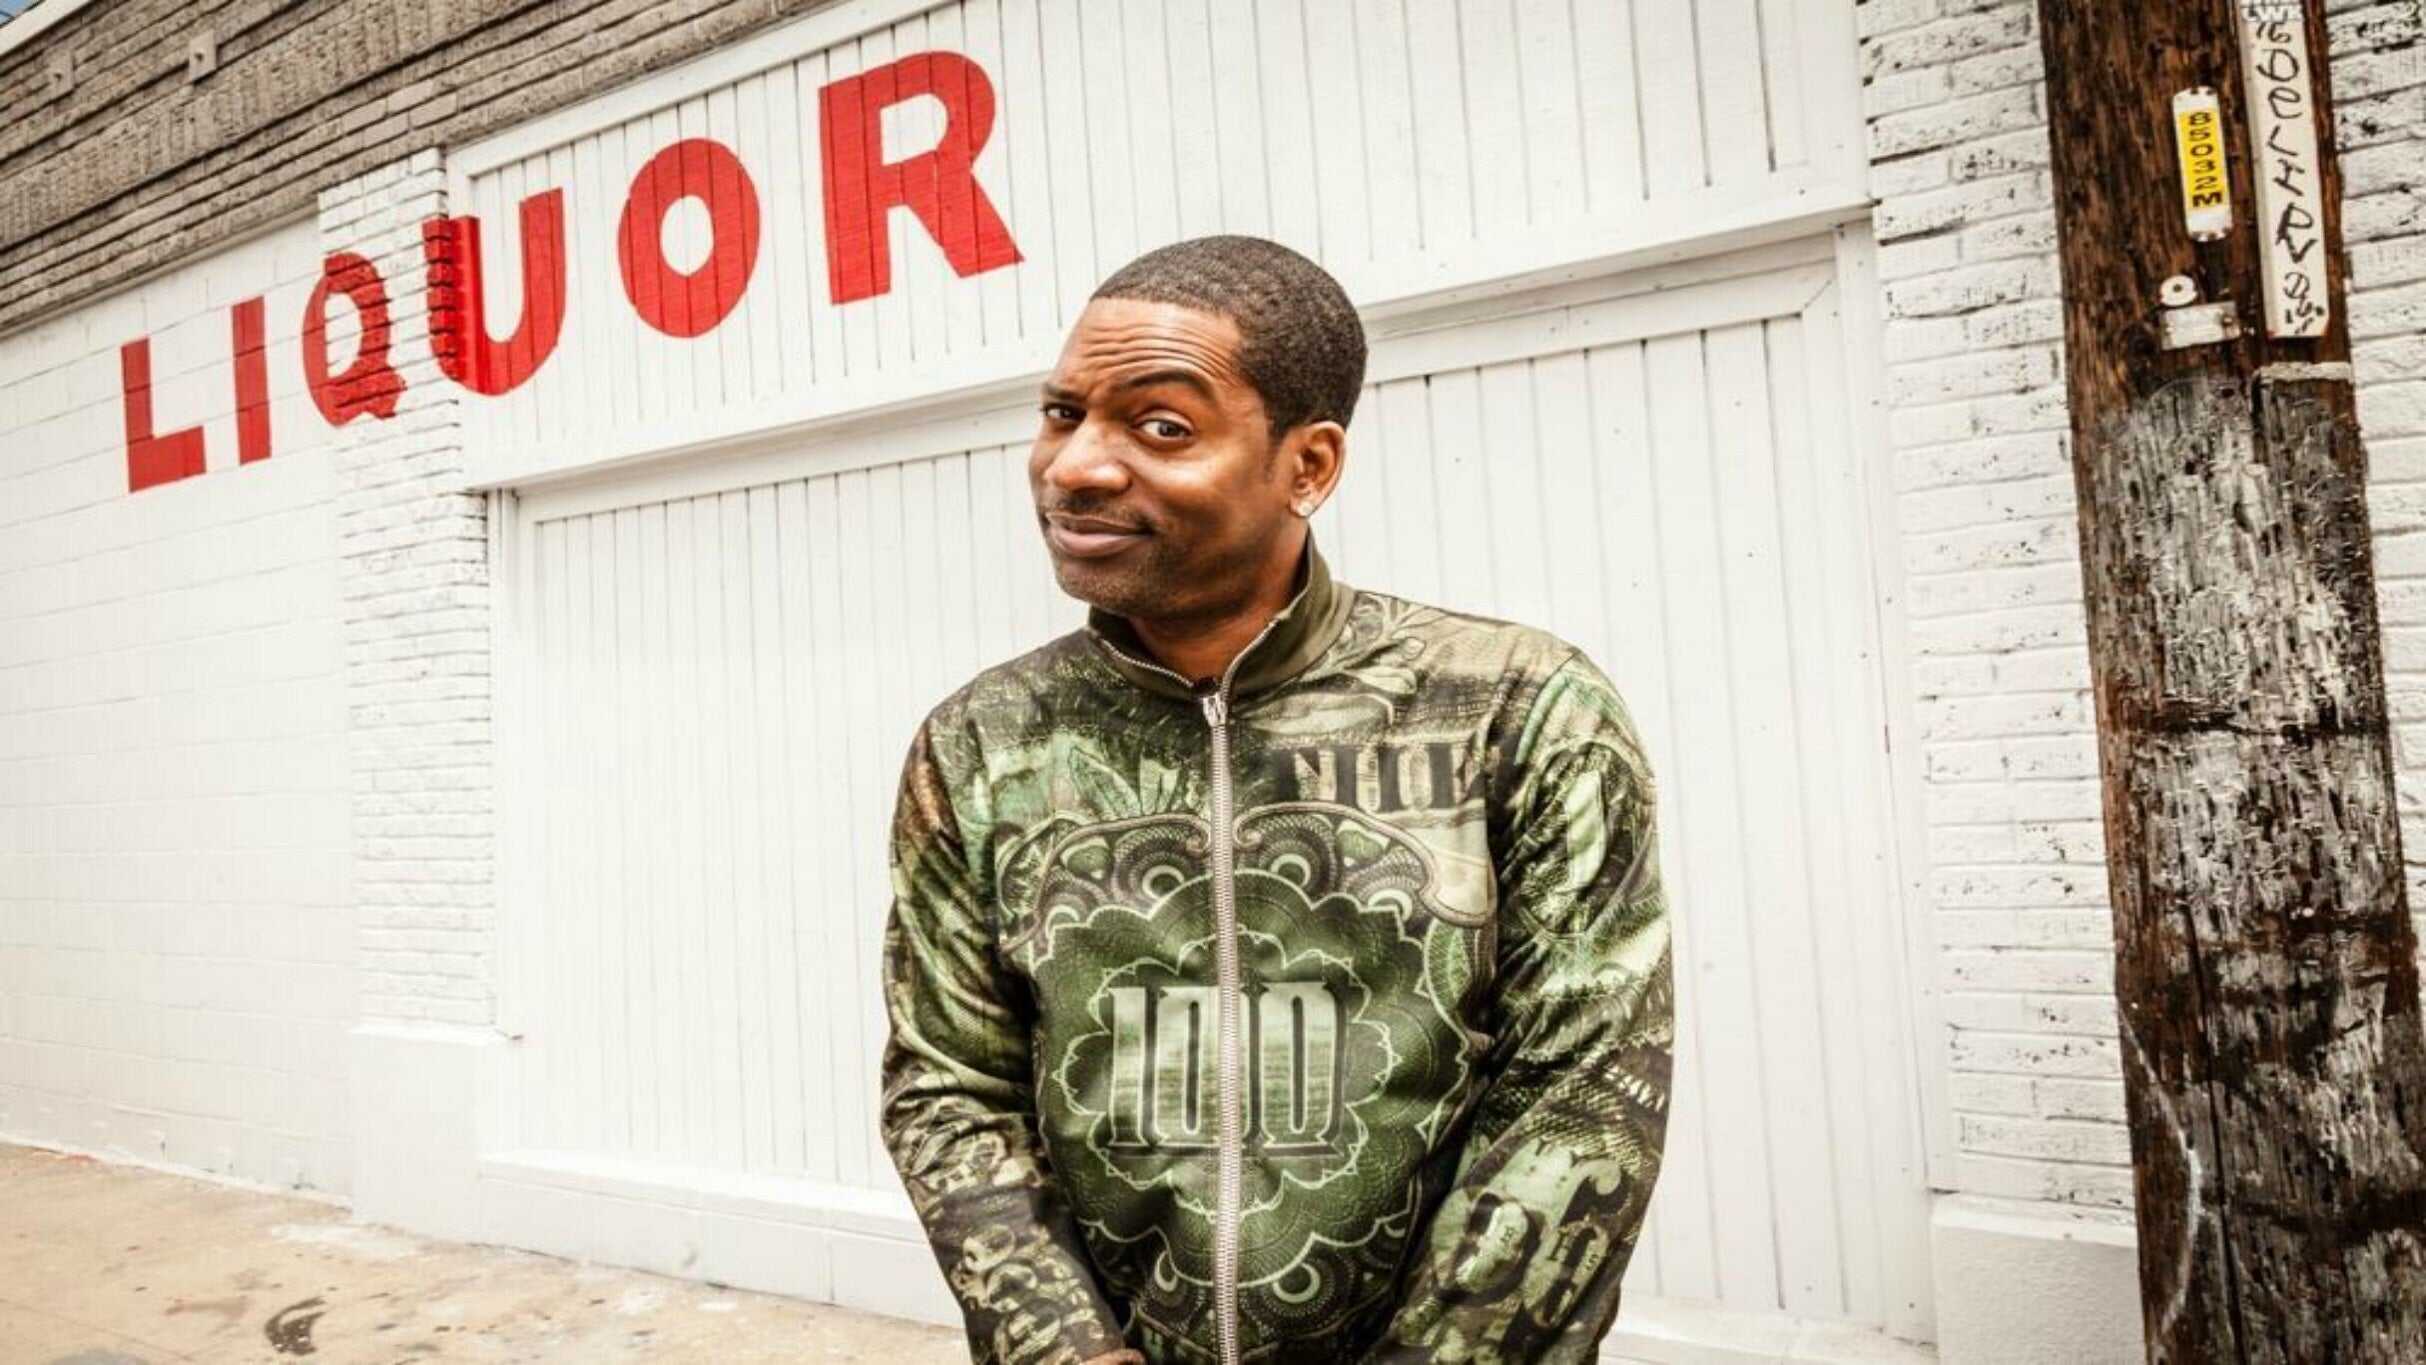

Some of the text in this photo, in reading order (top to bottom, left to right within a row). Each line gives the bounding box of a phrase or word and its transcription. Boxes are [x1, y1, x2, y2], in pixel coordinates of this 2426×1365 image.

[2188, 112, 2223, 208] 85032M
[121, 50, 1024, 493] LIQUOR
[1107, 982, 1342, 1150] 100
